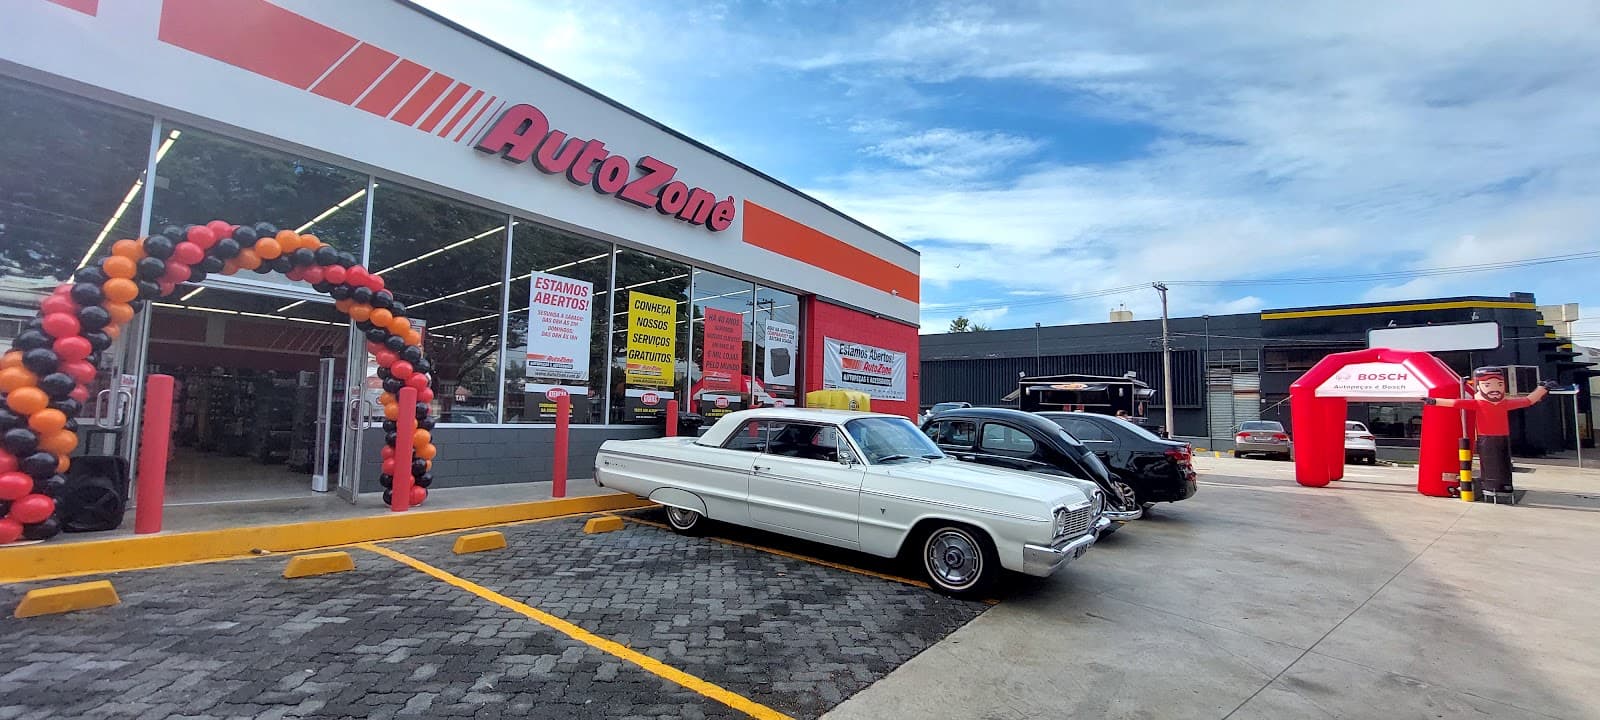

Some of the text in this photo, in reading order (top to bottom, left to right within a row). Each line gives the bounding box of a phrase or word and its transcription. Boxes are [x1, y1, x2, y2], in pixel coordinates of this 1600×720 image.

[535, 277, 588, 297] ESTAMOS
[533, 292, 590, 311] ABERTOS!
[634, 300, 671, 316] CONHEÇA
[637, 317, 669, 331] NOSSOS
[632, 333, 671, 348] SERVIÇOS
[628, 349, 673, 364] GRATUITOS.
[839, 343, 895, 364] Estamos Abertos!
[863, 361, 892, 375] AutoZone
[1358, 373, 1408, 381] BOSCH
